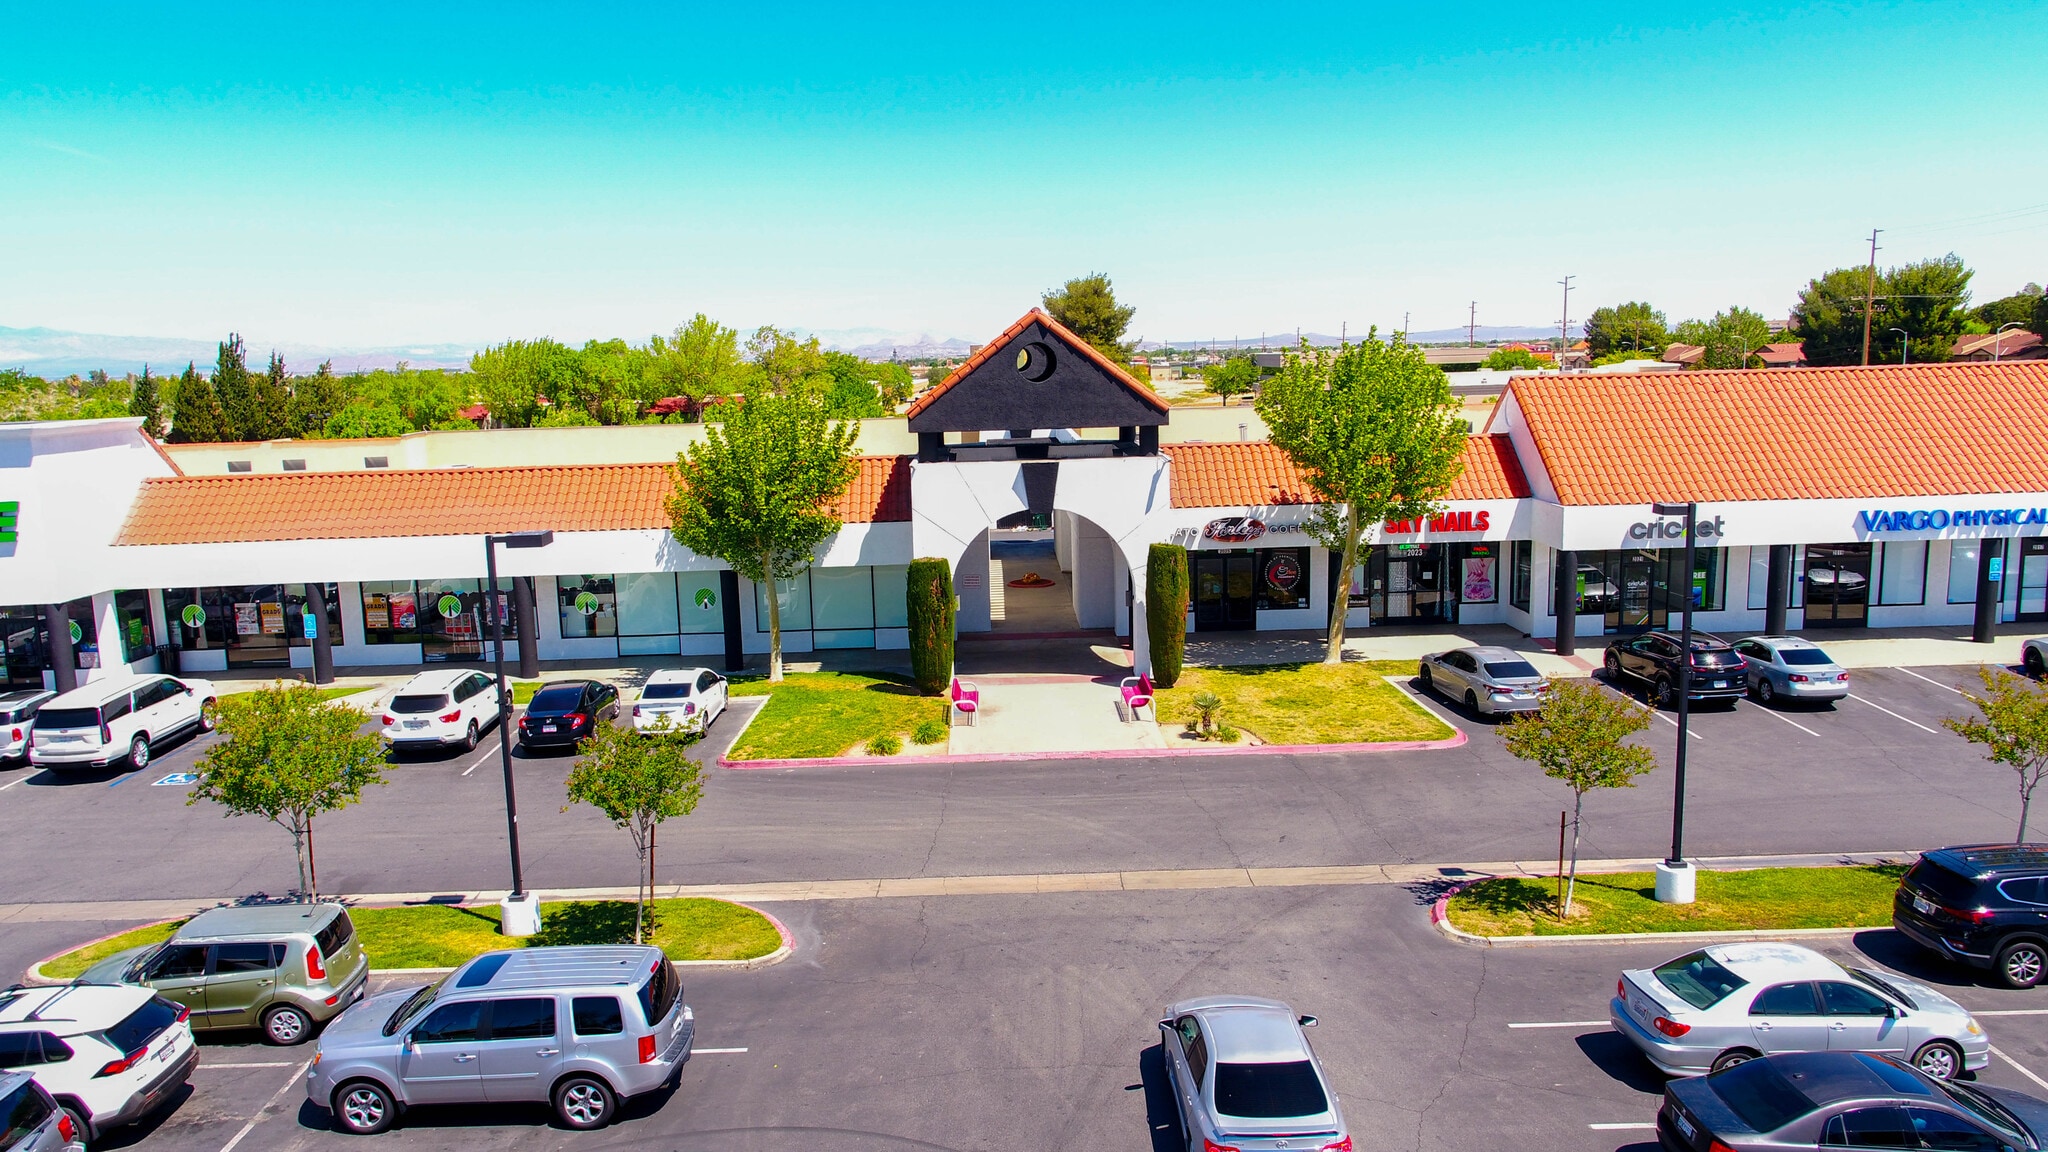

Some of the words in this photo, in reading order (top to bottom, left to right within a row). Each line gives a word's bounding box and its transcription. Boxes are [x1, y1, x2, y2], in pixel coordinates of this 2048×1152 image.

[1269, 523, 1319, 534] COFFE
[1385, 514, 1424, 534] SKY
[1430, 511, 1490, 533] NAILS
[1860, 509, 1950, 531] VARGO
[1953, 508, 2048, 526] PHYSICAL
